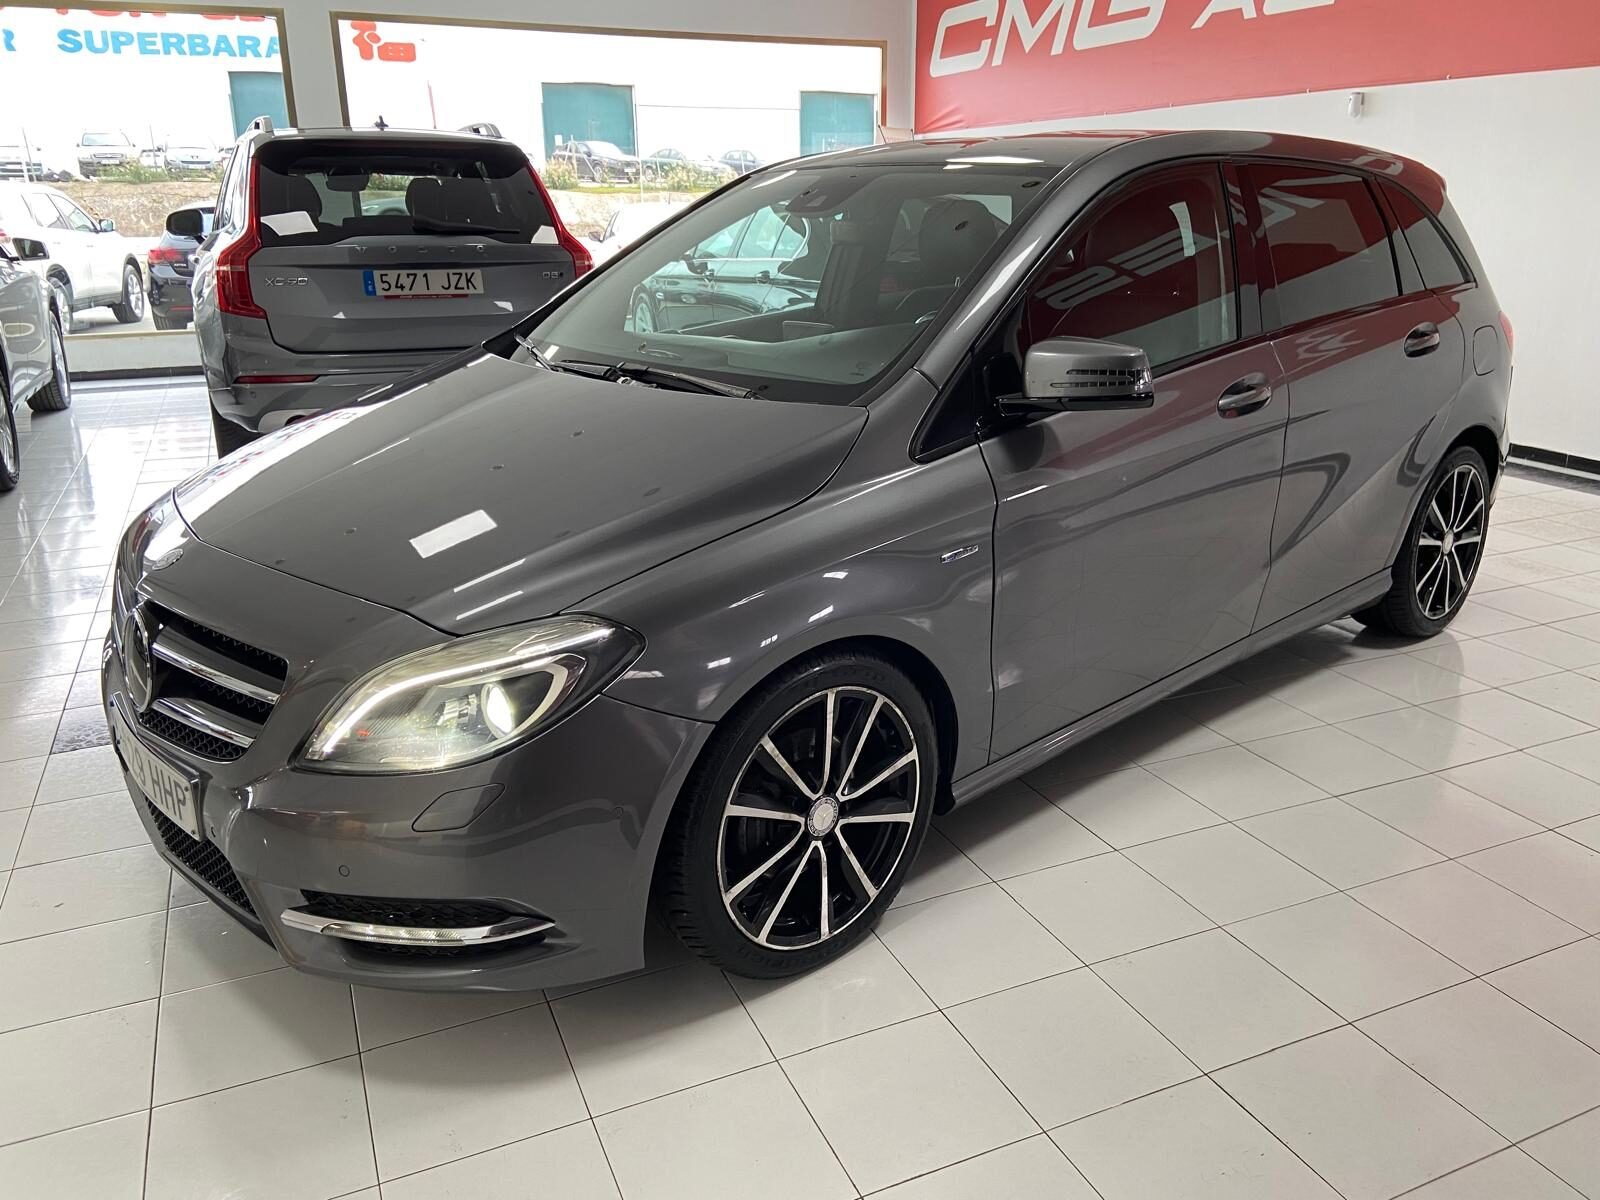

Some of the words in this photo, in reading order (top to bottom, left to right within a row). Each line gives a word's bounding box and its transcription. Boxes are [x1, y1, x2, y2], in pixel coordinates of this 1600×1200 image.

[929, 0, 1167, 77] CMG
[379, 272, 430, 292] 5471
[441, 272, 478, 291] JZK
[148, 759, 187, 820] HHP
